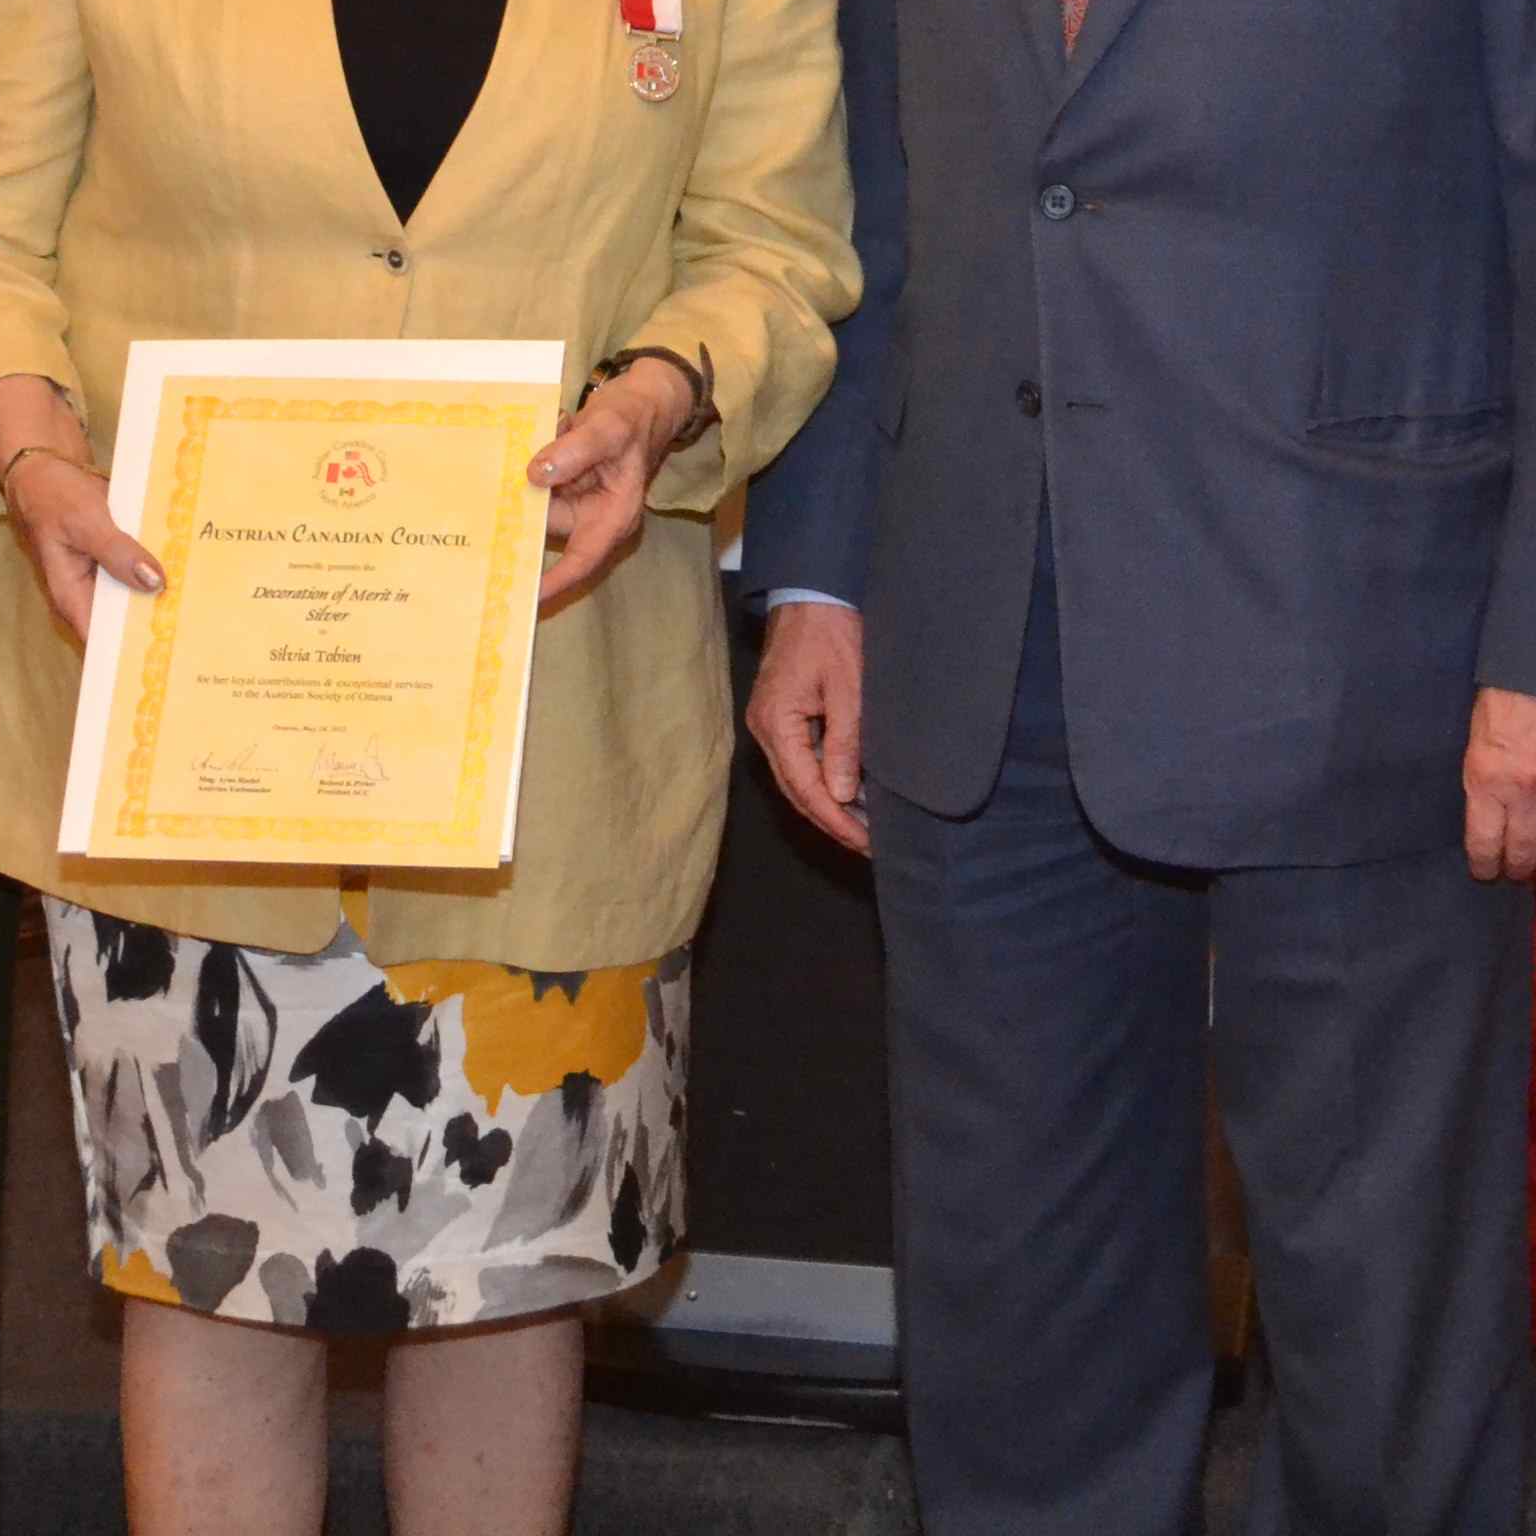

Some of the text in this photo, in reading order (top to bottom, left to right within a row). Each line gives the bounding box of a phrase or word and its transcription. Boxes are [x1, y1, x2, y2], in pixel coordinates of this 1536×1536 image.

[292, 523, 383, 544] CANADIAN
[390, 526, 471, 547] COUNCIL
[252, 582, 410, 604] Decoration of Merit in
[305, 605, 350, 622] Silver
[269, 644, 362, 663] Silvia Tobien
[196, 674, 211, 684] for
[213, 674, 230, 685] her
[232, 675, 256, 688] loyal
[244, 689, 260, 699] the
[307, 690, 341, 703] Society
[345, 690, 358, 701] of
